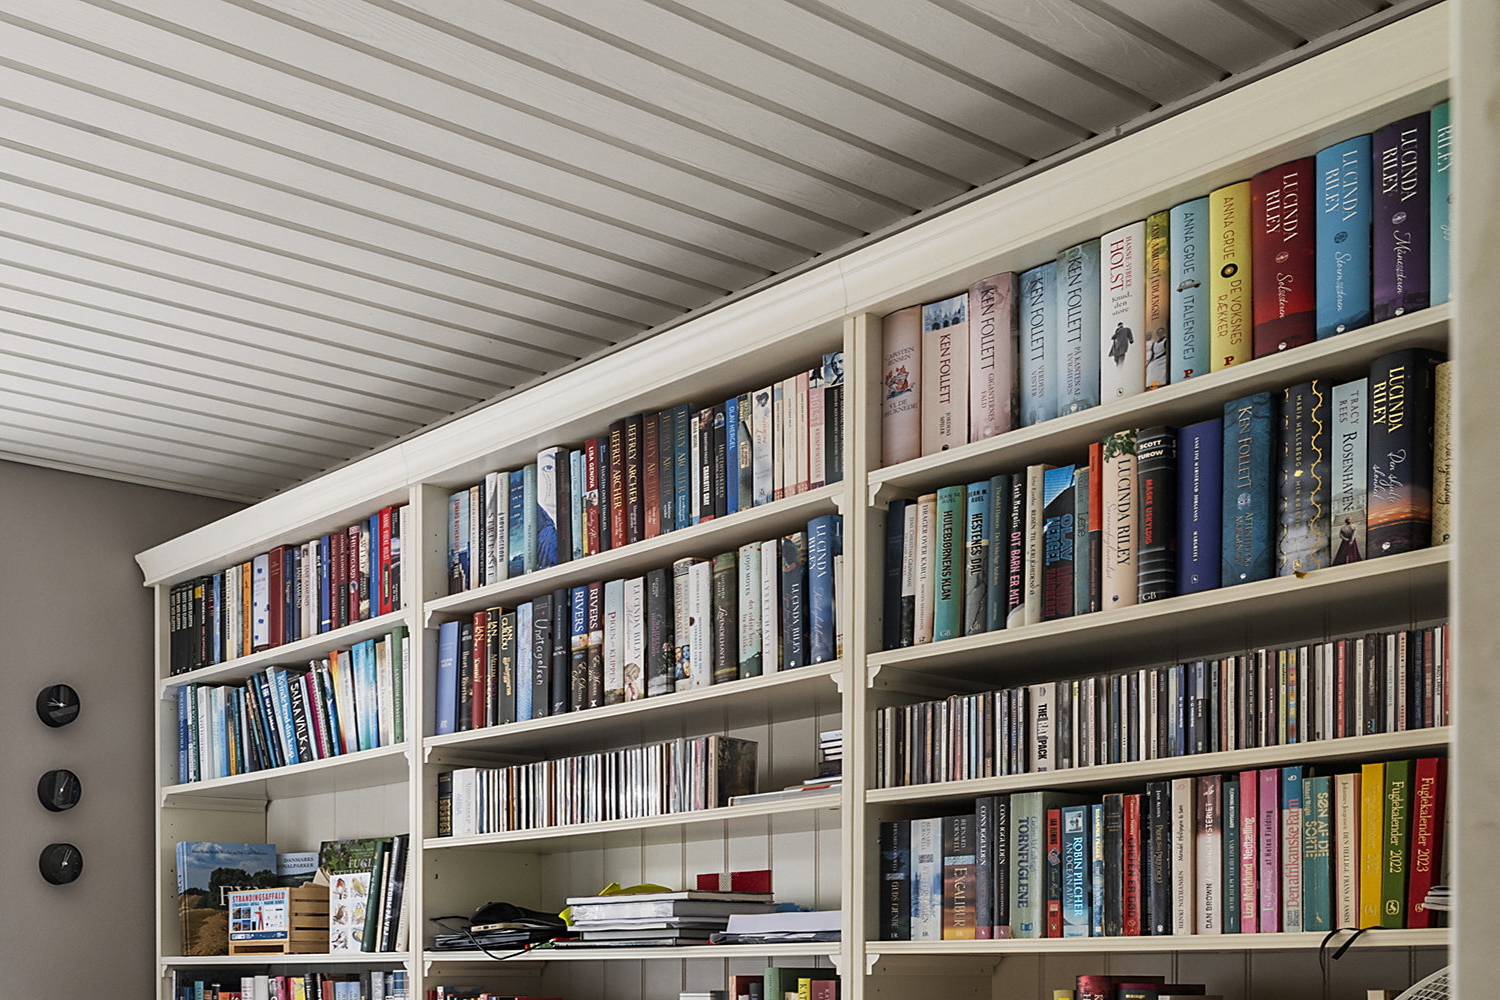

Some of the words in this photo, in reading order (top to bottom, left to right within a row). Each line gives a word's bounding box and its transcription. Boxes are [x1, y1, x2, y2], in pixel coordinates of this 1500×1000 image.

[1383, 146, 1398, 195] RILEY
[1401, 128, 1418, 202] LUCINDA
[1325, 168, 1340, 214] RILEY
[1343, 150, 1358, 221] LUCINDA
[1223, 197, 1235, 229] ANNA
[1266, 189, 1281, 235] RILEY
[1284, 172, 1298, 242] LUCINDA
[1184, 212, 1195, 243] ANNA
[1223, 230, 1235, 261] GRUE
[1068, 256, 1082, 287] KEN
[1110, 239, 1124, 292] HOLST
[1184, 244, 1195, 275] GRUE
[981, 288, 995, 316] KEN
[1030, 277, 1044, 306] KEN
[1230, 279, 1242, 295] DE
[1030, 306, 1045, 361] FOLLETT
[1068, 287, 1082, 343] FOLLETT
[1183, 295, 1195, 360] ITALIENSVEJ
[1217, 294, 1229, 338] RÆKKER
[1230, 296, 1242, 345] VOKSNES
[940, 334, 951, 357] KEN
[981, 318, 995, 370] FOLLETT
[940, 359, 951, 404] FOLLETT
[1388, 366, 1405, 434] LUCINDA
[1238, 405, 1253, 433] KEN
[1373, 381, 1387, 425] RILEY
[612, 430, 621, 466] JEFFREY
[628, 424, 637, 460] JEFFREY
[647, 422, 655, 461] JEFFREY
[663, 415, 671, 453] JEFFREY
[678, 411, 686, 451] JEFFREY
[1139, 439, 1162, 450] SCOTT
[678, 452, 686, 493] ARCHER
[1137, 449, 1164, 461] TUROW
[1237, 436, 1252, 488] FOLLETT
[1386, 449, 1406, 471] Den
[613, 470, 623, 509] ARCHER
[629, 463, 637, 504] ARCHER
[647, 463, 655, 503] ARCHER
[663, 456, 671, 496] ARCHER
[1116, 458, 1131, 523] LUCINDA
[808, 536, 816, 570] RILEY
[816, 524, 827, 578] LUCINDA
[941, 510, 954, 577] HULEBJØRNENS
[970, 513, 983, 555] HESTENES
[1011, 530, 1021, 546] DIT
[1046, 516, 1060, 565] HERGEL
[1060, 513, 1073, 560] OLAV
[1116, 526, 1131, 566] RILEY
[349, 535, 357, 579] HILDEGARD
[970, 558, 982, 576] DAL
[1010, 549, 1021, 573] BARN
[941, 578, 952, 601] KLAN
[1009, 589, 1020, 605] MIT
[1010, 575, 1020, 587] ER
[574, 590, 584, 632] RIVERS
[590, 588, 599, 630] RIVERS
[633, 584, 641, 631] LUCINDA
[792, 583, 800, 626] LUCINDA
[607, 611, 617, 639] PIGEN
[792, 627, 800, 654] RILEY
[533, 618, 549, 686] Undtagelsen
[609, 648, 617, 684] KLIPPEN
[633, 633, 641, 660] RILEY
[277, 674, 288, 702] Kvinde
[281, 703, 290, 723] kend
[285, 724, 293, 738] din
[287, 738, 296, 758] krop
[295, 715, 308, 754] VALKA
[1285, 798, 1300, 825] Farm
[1389, 781, 1405, 846] Fuglekalender
[1418, 777, 1434, 846] Fuglekalender
[1244, 816, 1255, 860] Nedtælling
[1285, 827, 1300, 884] afrikanske
[1017, 817, 1030, 908] TORNFUGLENE
[1389, 849, 1403, 874] 2022
[1416, 848, 1430, 873] 2023
[232, 892, 285, 903] STRANDINGSAFFALD
[954, 867, 968, 927] EXCALIBUR
[1243, 864, 1253, 901] Marklund
[1286, 885, 1299, 908] Den
[1244, 903, 1254, 919] Liza
